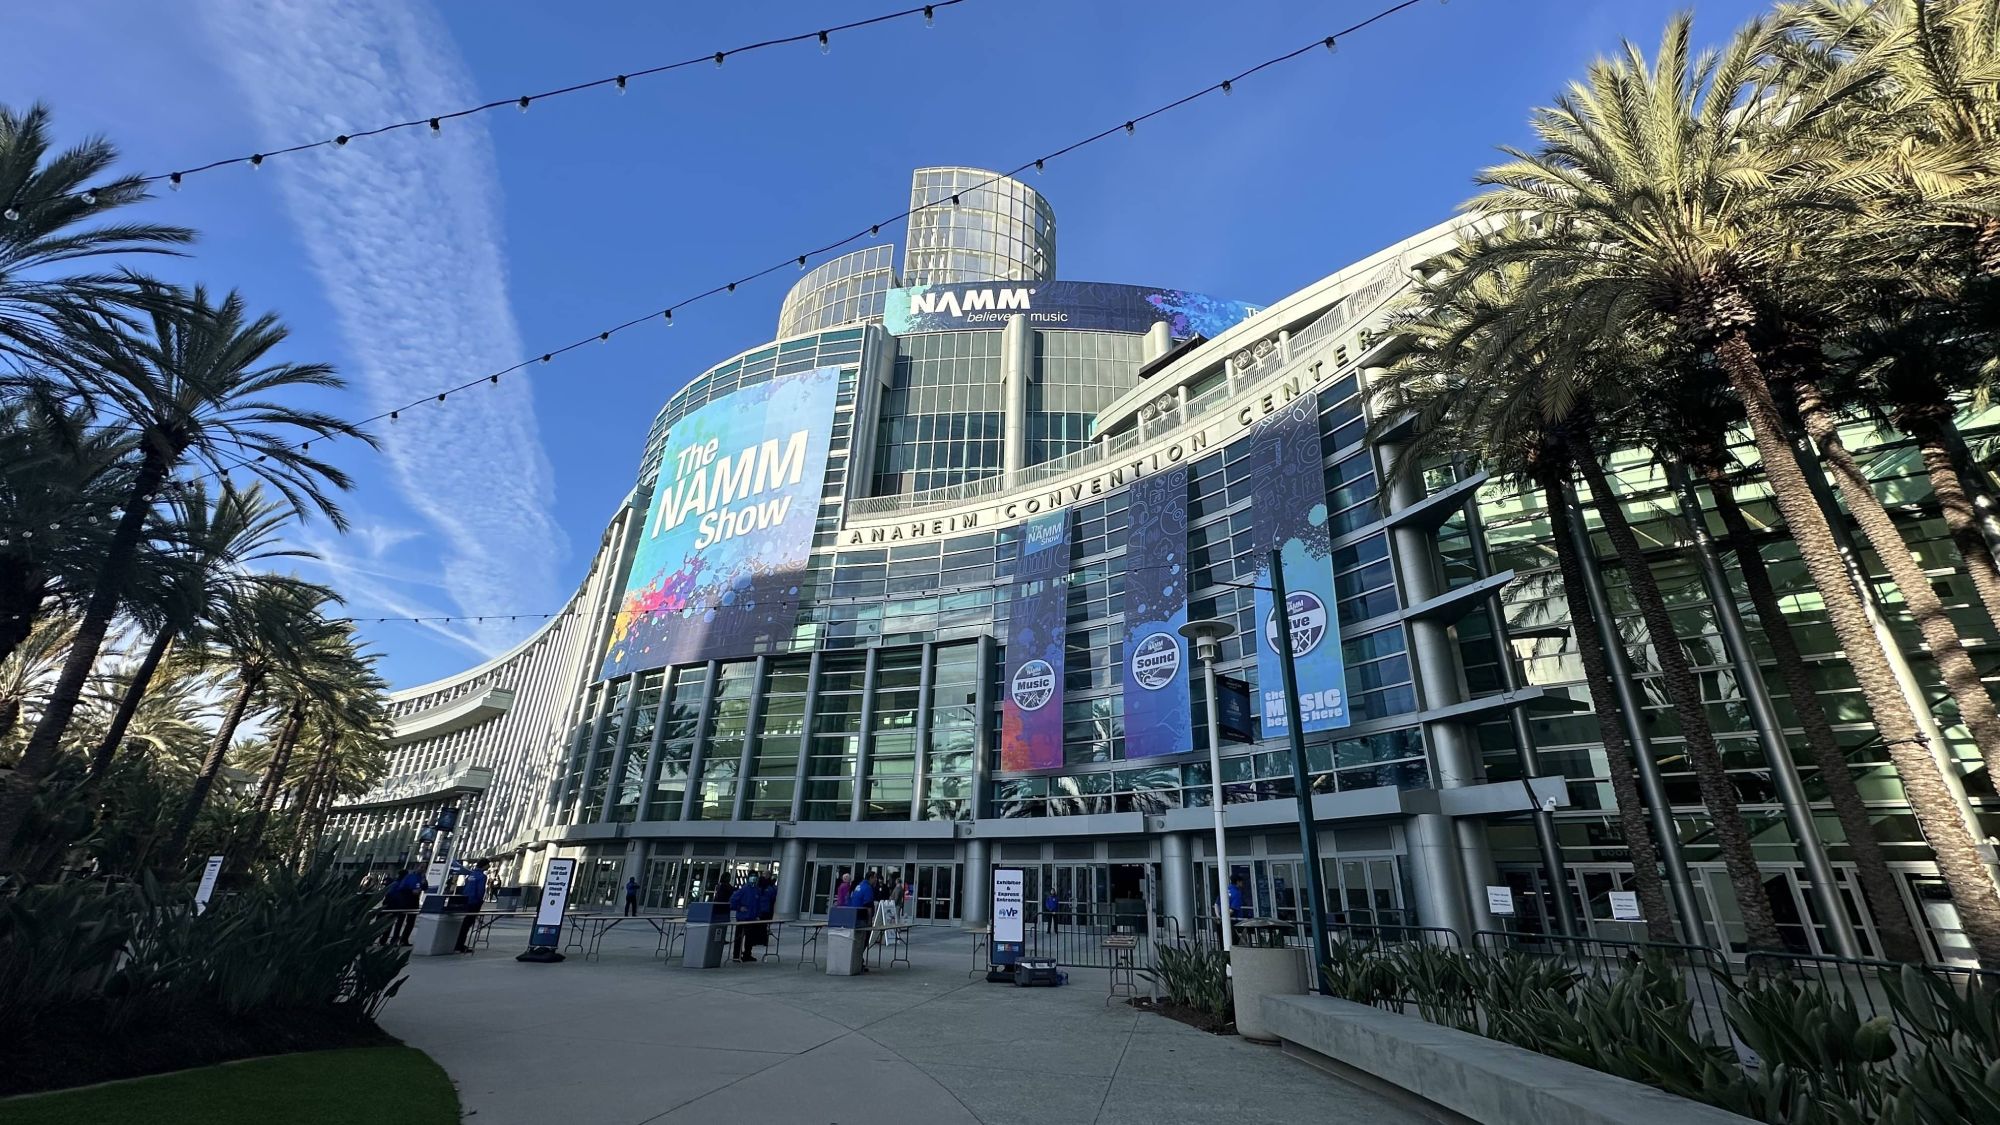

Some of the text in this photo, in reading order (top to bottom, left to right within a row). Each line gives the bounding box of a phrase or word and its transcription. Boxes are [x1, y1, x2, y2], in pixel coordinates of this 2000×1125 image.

[966, 311, 1010, 323] believe
[1030, 311, 1068, 322] music
[849, 327, 1374, 545] ANAHEIM CONVENTION CENTER
[675, 436, 720, 481] The
[651, 430, 810, 540] NAMM
[694, 495, 793, 551] Show
[1027, 522, 1062, 544] NAMM
[1031, 524, 1044, 532] The
[1040, 534, 1060, 546] Show
[1288, 616, 1311, 630] ive
[1137, 652, 1175, 669] Sound
[1017, 678, 1050, 691] Music
[1265, 688, 1342, 718] MSIC
[1266, 707, 1343, 728] begs here
